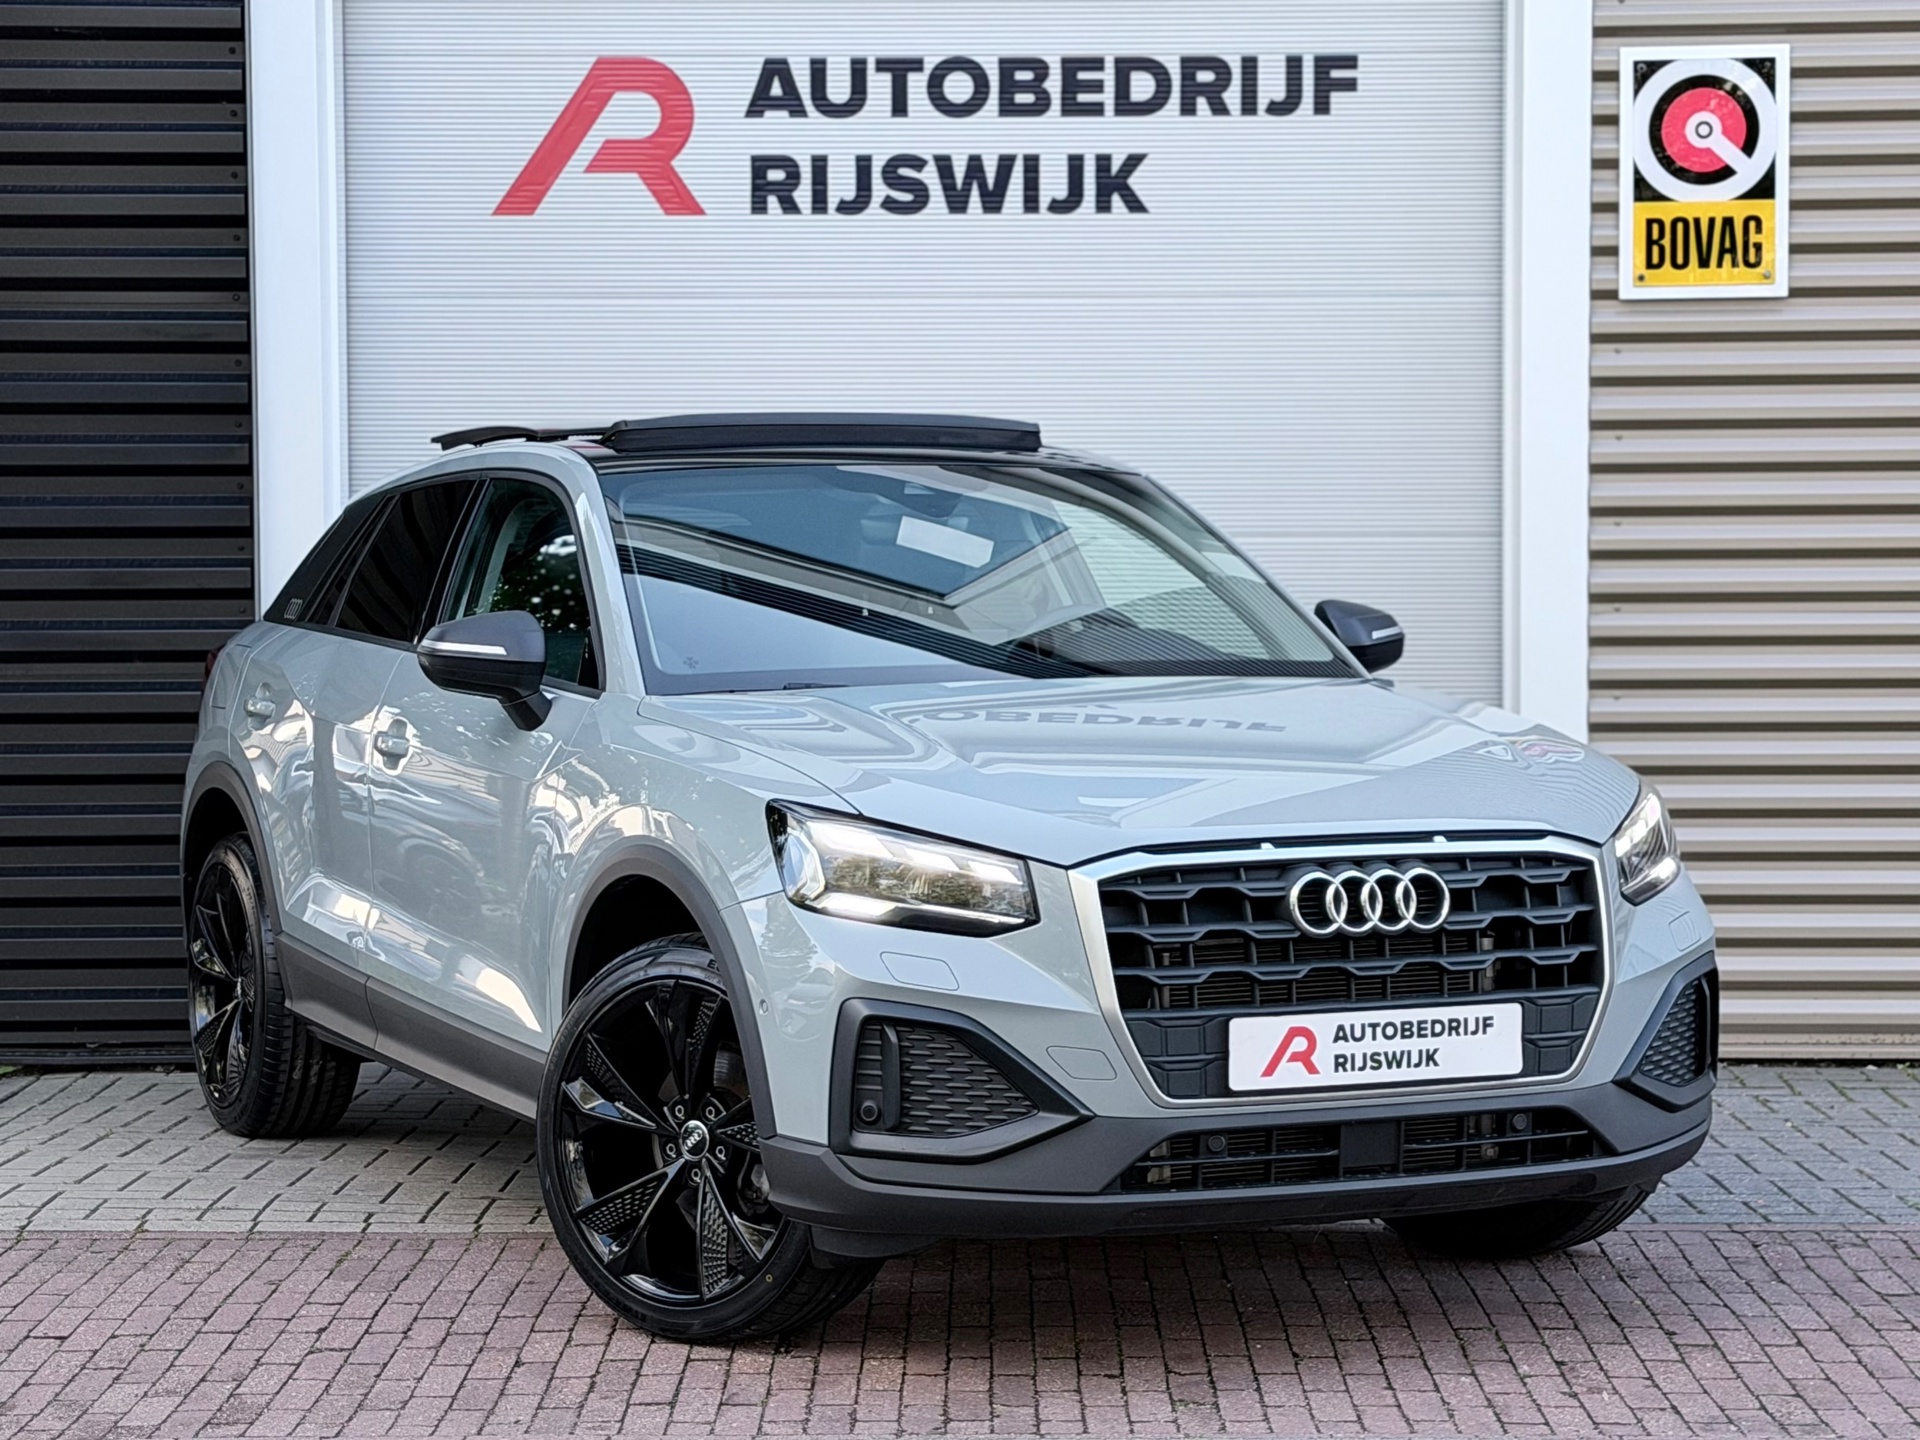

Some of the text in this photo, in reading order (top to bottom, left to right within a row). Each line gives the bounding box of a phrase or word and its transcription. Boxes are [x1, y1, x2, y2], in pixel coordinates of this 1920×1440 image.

[744, 55, 1359, 118] AUTOBEDRIJF
[751, 154, 1149, 215] RIJSWIJK
[1645, 215, 1763, 270] BOVAG
[1332, 1016, 1494, 1043] AUTOBEDRIJF
[1333, 1048, 1440, 1073] RIJSWIJK
